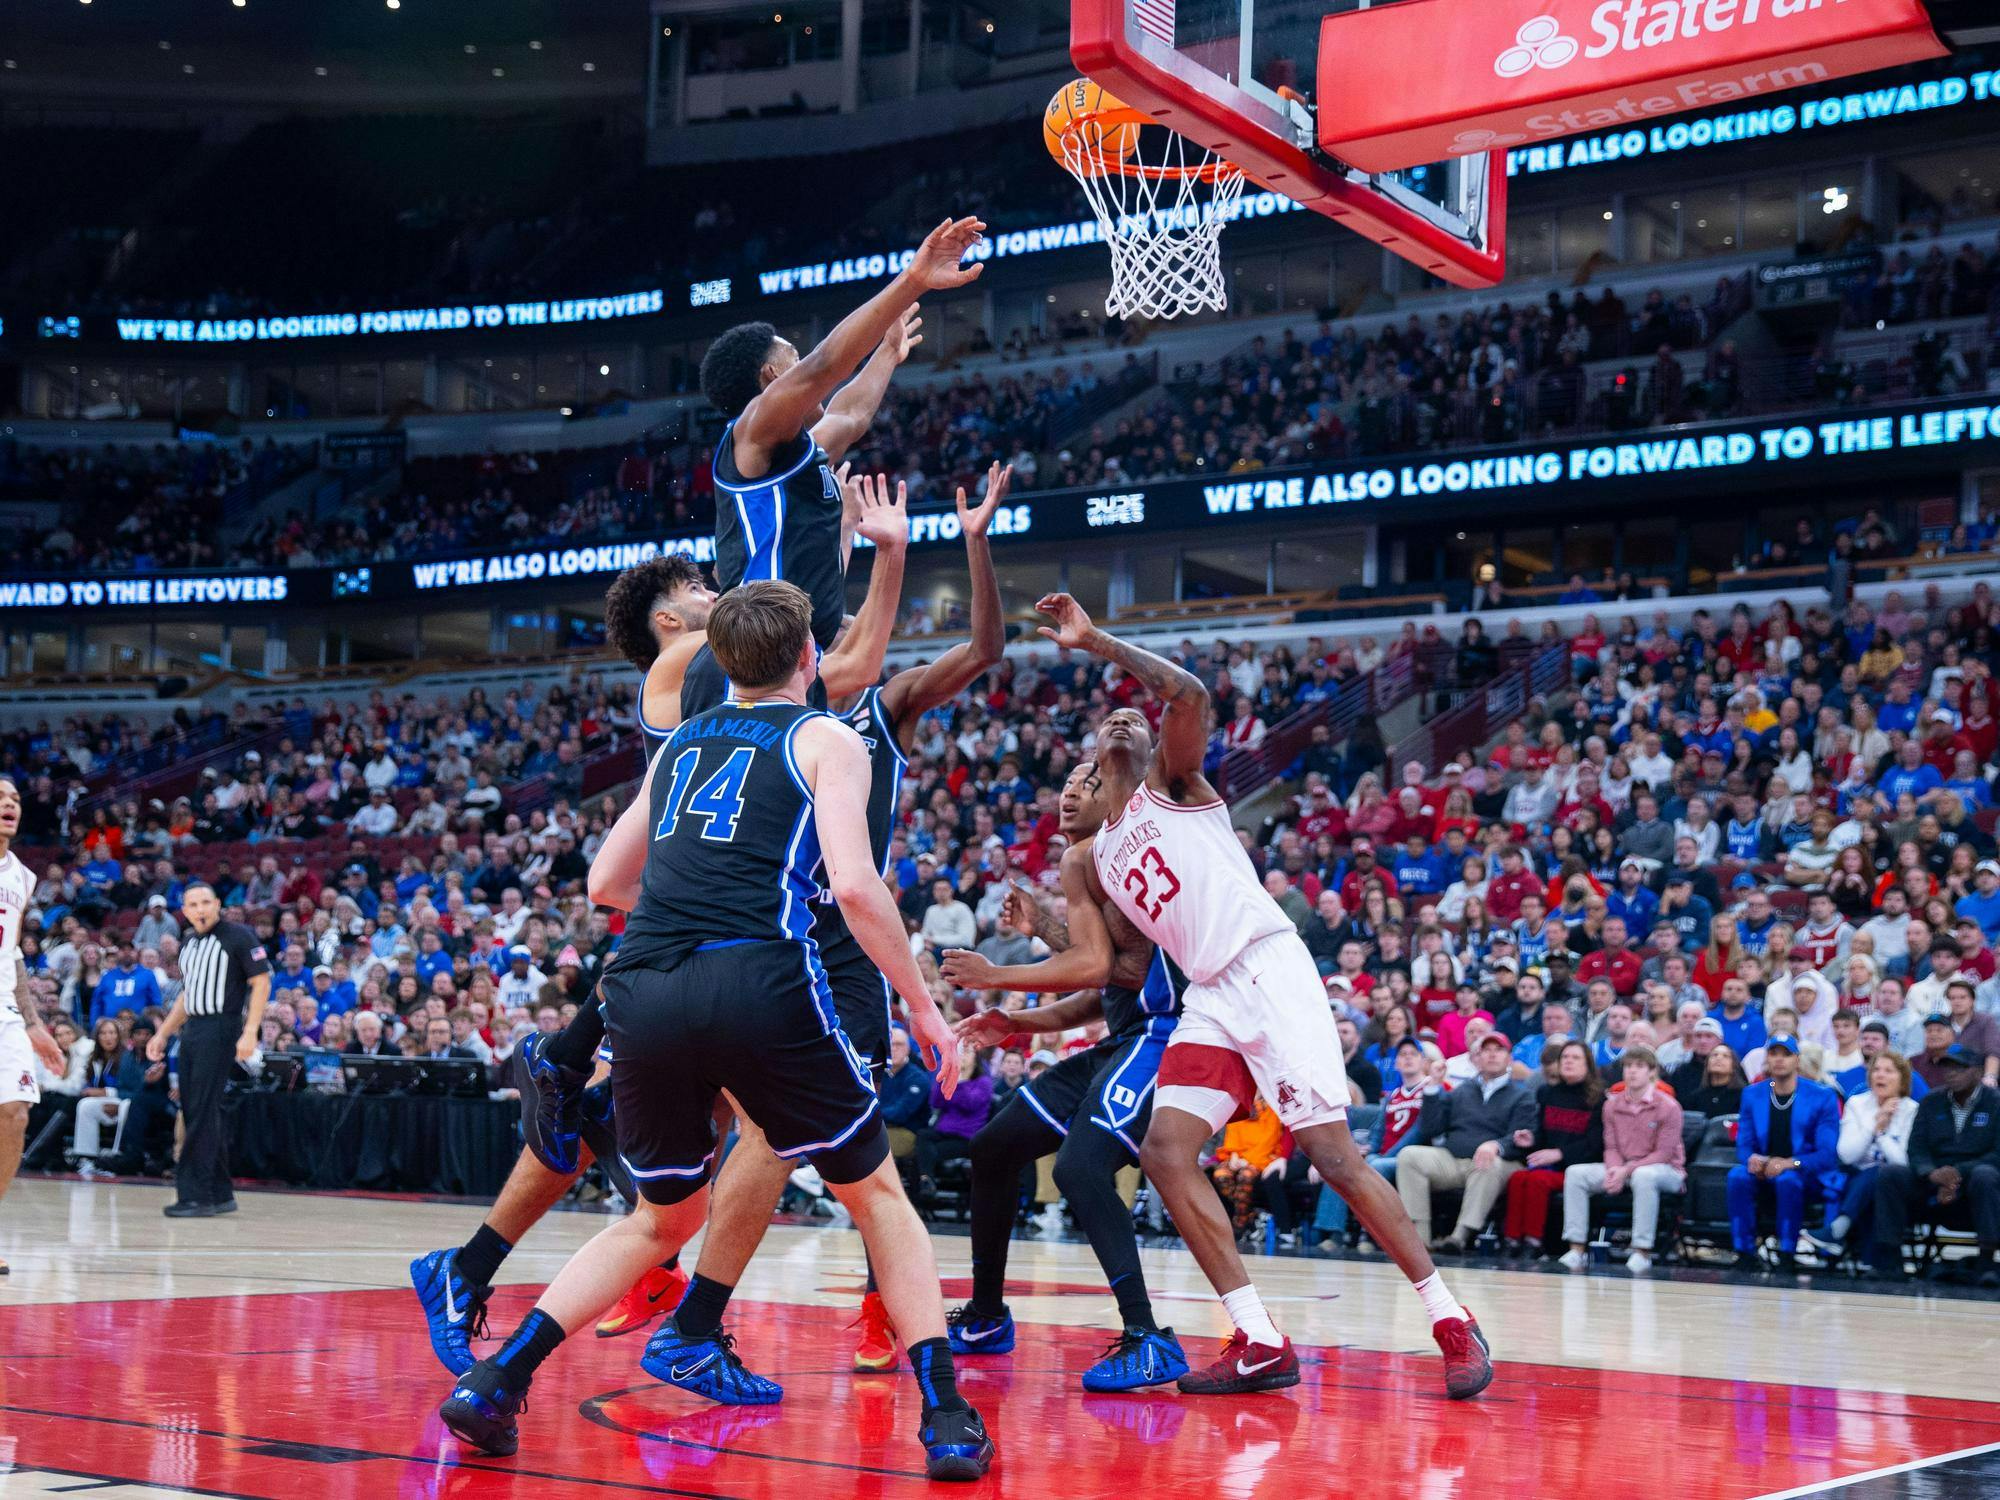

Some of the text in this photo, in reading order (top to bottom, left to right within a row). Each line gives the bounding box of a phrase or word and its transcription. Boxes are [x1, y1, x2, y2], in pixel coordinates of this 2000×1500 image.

[1567, 129, 1647, 167] ALSO
[1650, 105, 1797, 154] LOOKING
[1801, 77, 1967, 129] FORWARD
[759, 263, 828, 295] WE'RE
[829, 254, 886, 284] ALSO
[888, 236, 995, 274] LONG
[117, 290, 664, 341] WE'RE ALSO LOOKING FORWARD TO THE LEFTOVERS
[1203, 478, 1305, 515] WE'RE
[1308, 469, 1396, 505] ALSO
[1400, 452, 1564, 496] LOOKING
[1568, 434, 1757, 480] FORWARD
[1760, 427, 1814, 461] TO
[1818, 417, 1894, 455] THE
[70, 581, 104, 606] TO
[105, 579, 152, 605] THE
[154, 576, 288, 604] LEFTOVERS
[413, 559, 485, 589] WE'RE
[486, 552, 547, 583] ALSO
[548, 541, 659, 577] LOOKING
[671, 717, 784, 752] KHAMENIA
[655, 746, 757, 843] 14
[1123, 845, 1181, 924] 23
